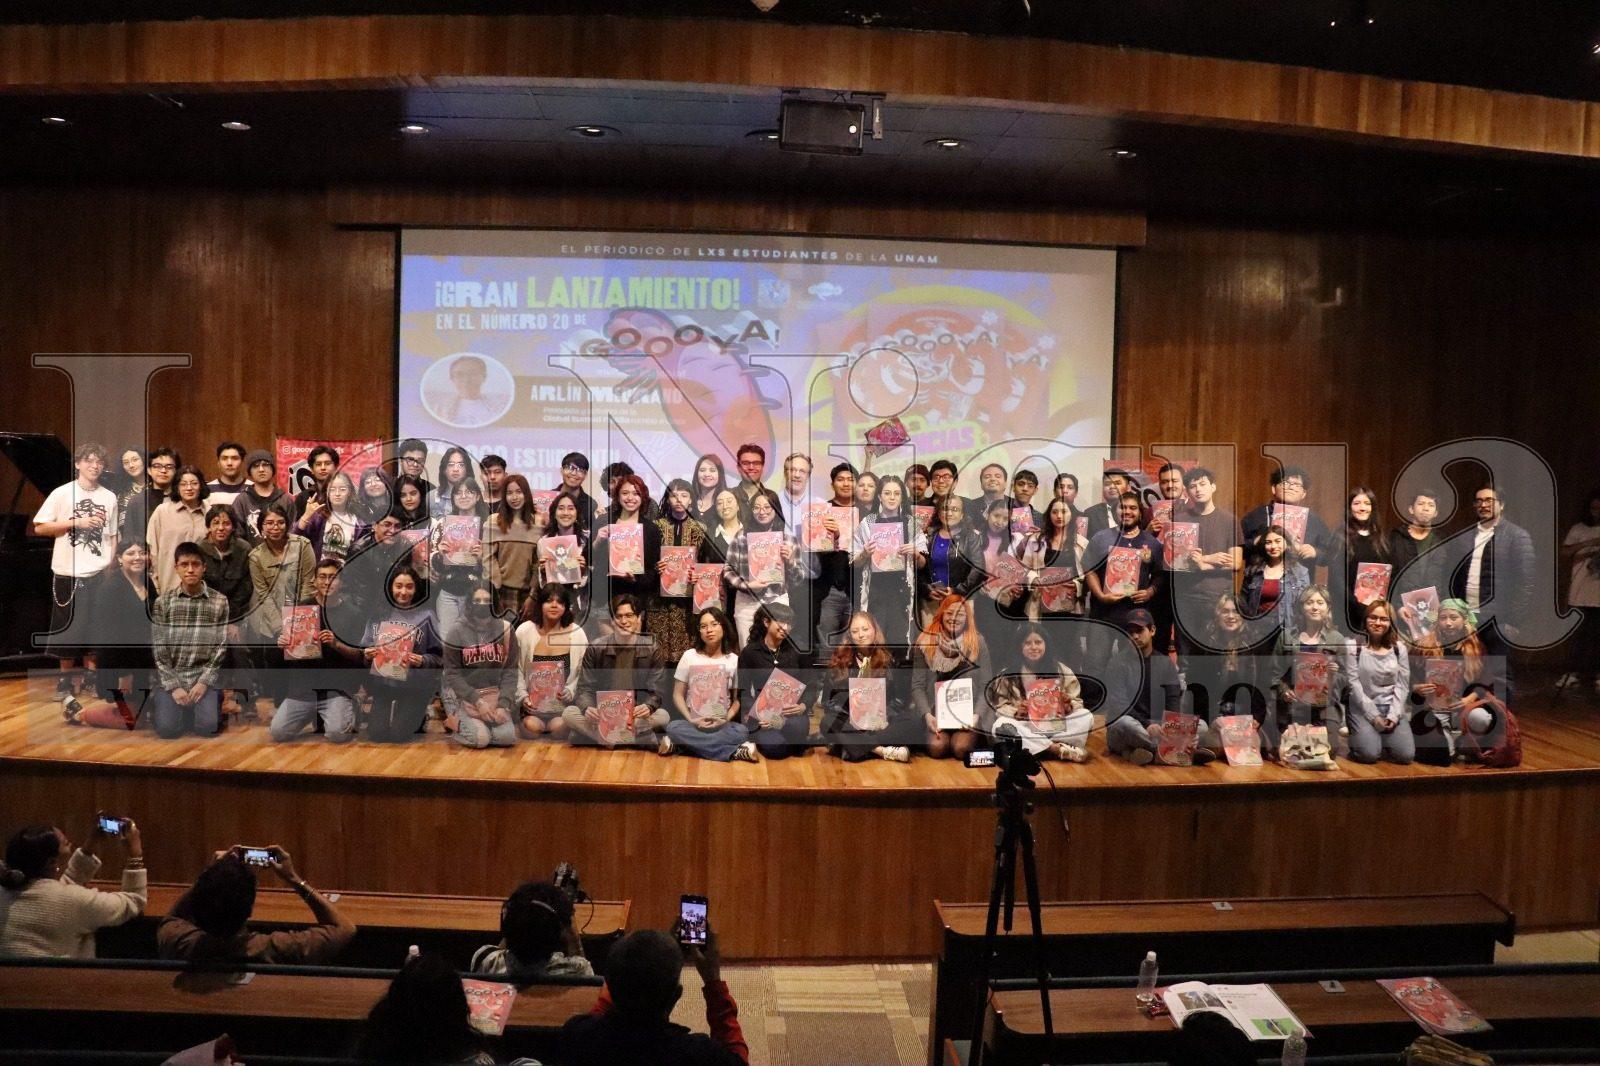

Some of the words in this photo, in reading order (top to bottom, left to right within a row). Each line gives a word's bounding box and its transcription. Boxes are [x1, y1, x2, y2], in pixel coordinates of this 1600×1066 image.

[560, 244, 577, 254] EL
[584, 243, 666, 256] PERIÓDICO
[673, 246, 691, 257] DE
[698, 247, 726, 257] LXS
[732, 248, 839, 261] ESTUDIANTES
[845, 251, 864, 262] DE
[871, 253, 888, 262] LA
[894, 253, 939, 264] UNAM
[526, 275, 741, 311] LANZAMIENTO!
[435, 314, 454, 330] EN
[457, 314, 476, 330] EL
[552, 314, 570, 330] 20
[574, 313, 588, 326] DE
